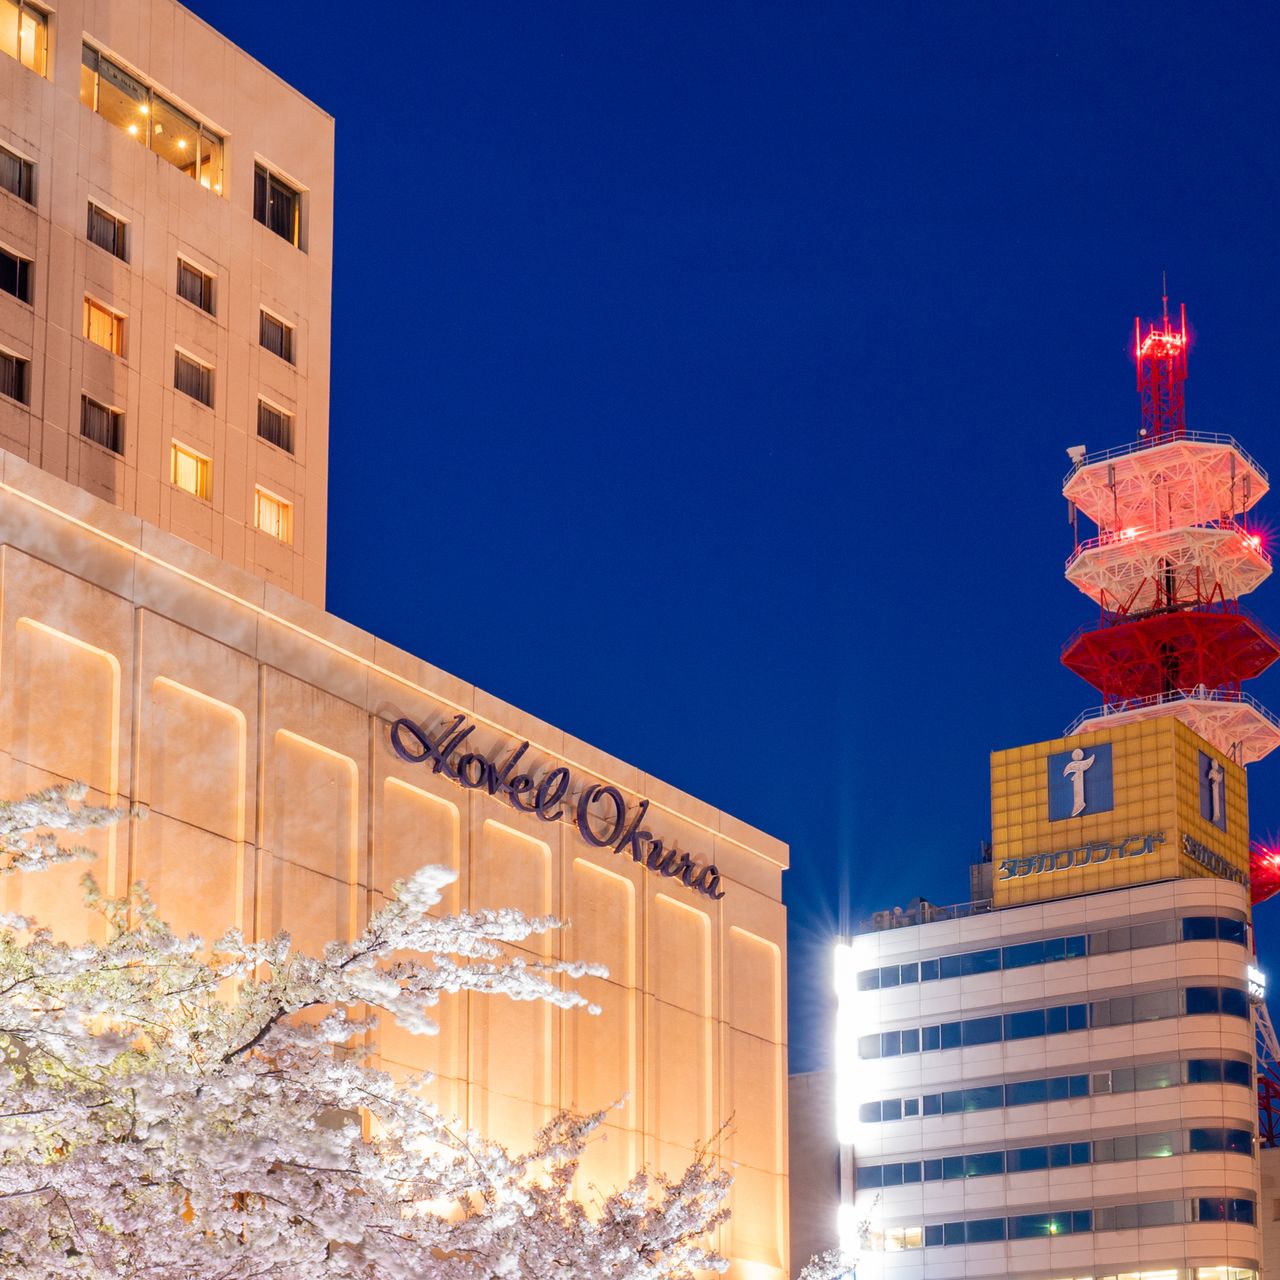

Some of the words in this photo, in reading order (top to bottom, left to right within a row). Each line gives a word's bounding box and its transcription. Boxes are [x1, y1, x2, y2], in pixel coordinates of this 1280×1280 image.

[390, 714, 569, 821] Hotel
[577, 785, 725, 900] Okura
[999, 832, 1166, 881] タチカワブラインド
